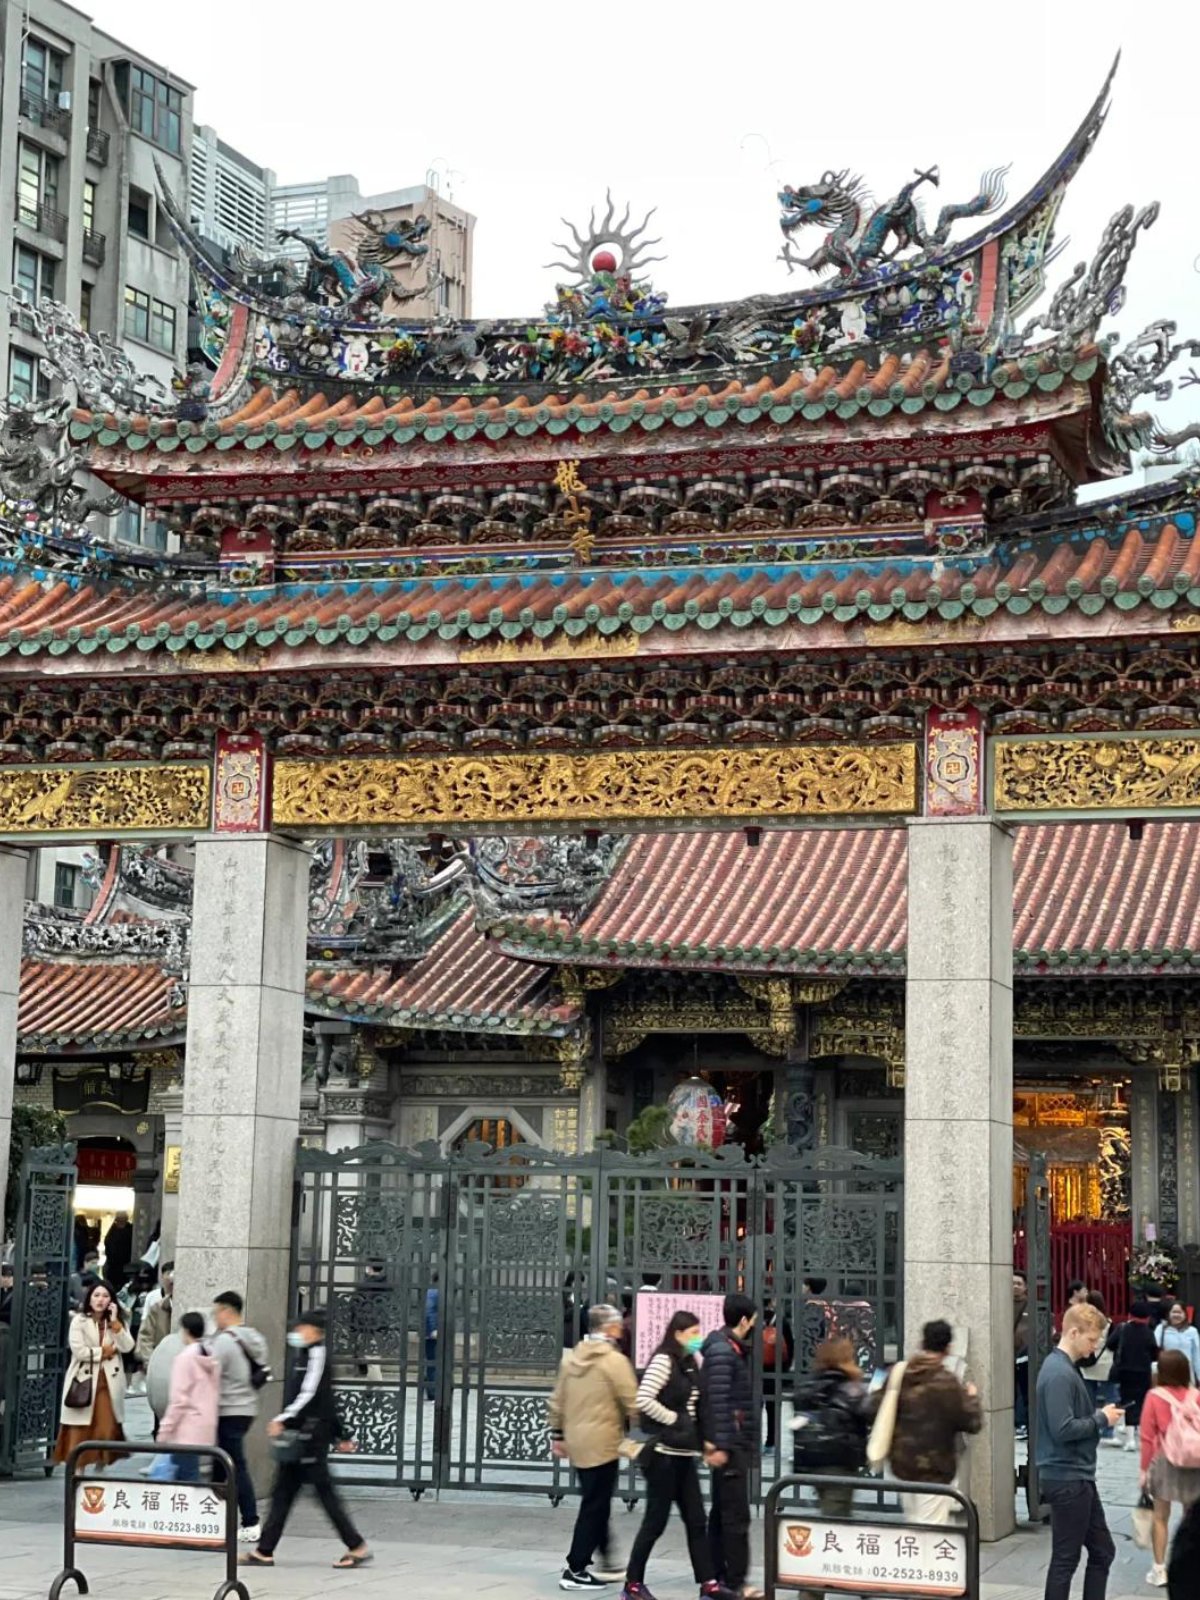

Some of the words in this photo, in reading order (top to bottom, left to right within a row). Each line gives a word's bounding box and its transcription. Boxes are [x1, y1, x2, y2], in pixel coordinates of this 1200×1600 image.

[553, 458, 596, 564] 龍山寺
[112, 1489, 221, 1515] 良福保全
[153, 1520, 220, 1534] 02-2523-8939
[821, 1530, 959, 1561] 良福保全
[872, 1566, 959, 1583] 02-2523-8939
